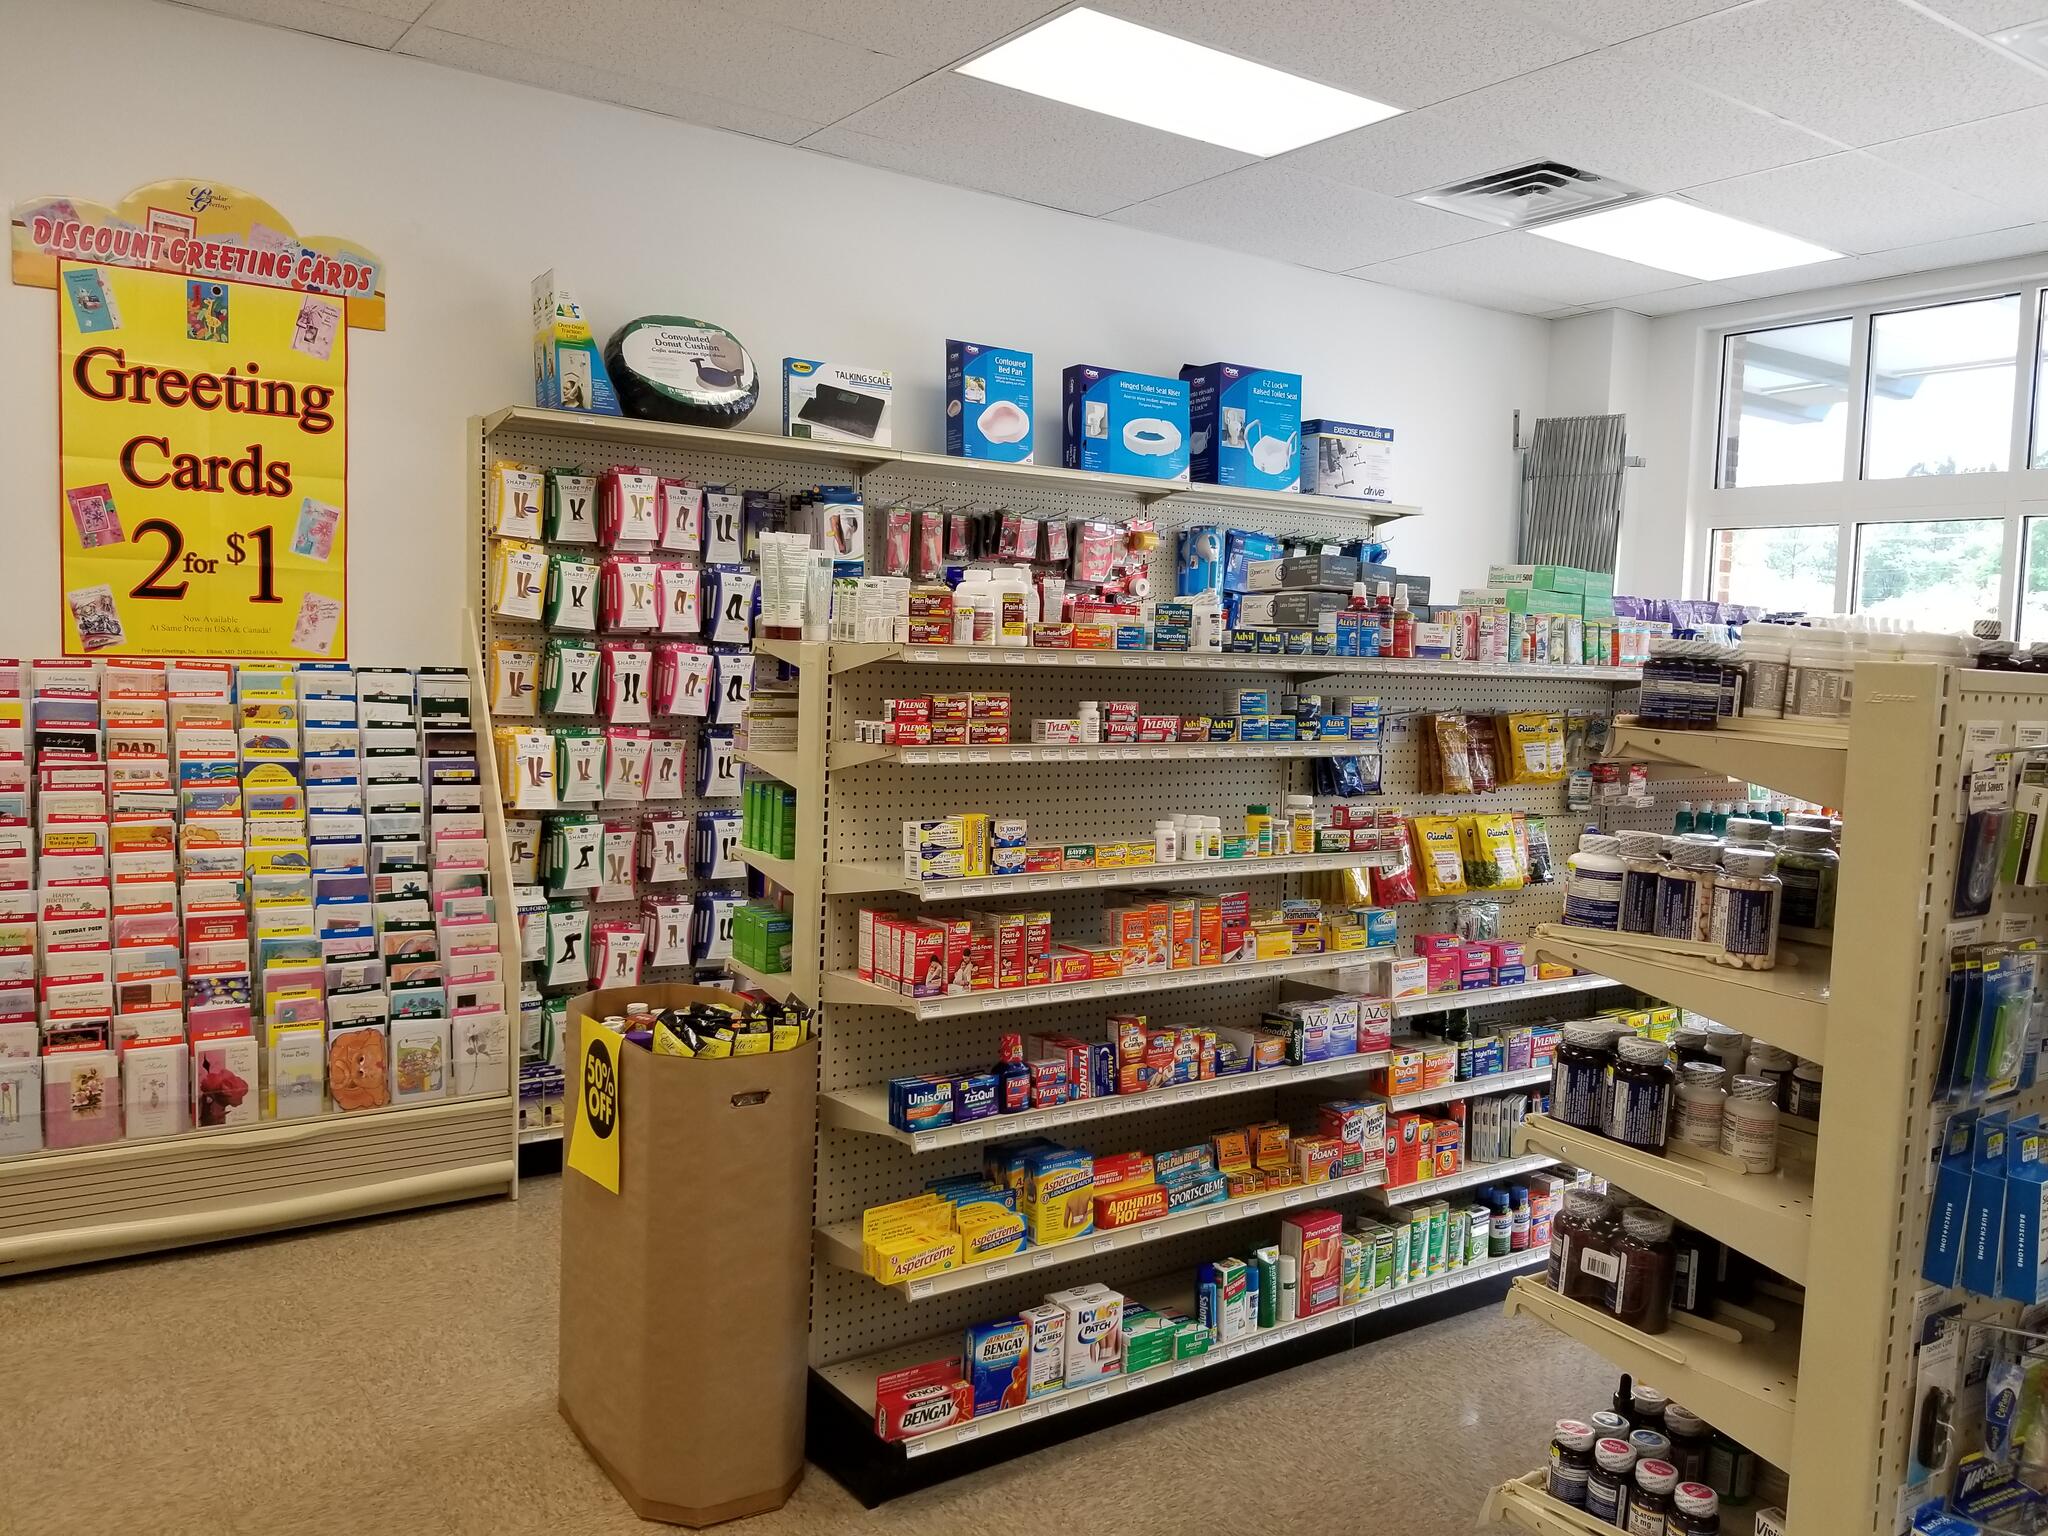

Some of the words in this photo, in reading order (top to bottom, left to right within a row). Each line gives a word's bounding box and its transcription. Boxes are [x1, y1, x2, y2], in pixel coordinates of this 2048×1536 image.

[32, 216, 166, 261] DISCOUNT
[169, 238, 299, 280] GREETING
[299, 256, 374, 292] CARDS
[660, 331, 711, 344] Convoluted
[655, 338, 682, 349] Donut
[684, 342, 720, 352] Cushion
[994, 356, 1027, 369] Contoured
[998, 366, 1010, 374] Bed
[1011, 367, 1023, 376] Pan
[835, 370, 868, 383] TALKING
[868, 375, 891, 386] SCALE
[1262, 379, 1271, 387] E-Z
[73, 346, 335, 434] Greeting
[1120, 381, 1139, 392] Hinged
[1139, 383, 1155, 394] Toilet
[1155, 385, 1167, 395] Seat
[1167, 386, 1182, 397] Riser
[1252, 387, 1270, 397] Raised
[1271, 389, 1286, 398] Toilet
[1286, 392, 1298, 400] Seat
[1333, 426, 1358, 437] EXERCISE
[1358, 429, 1382, 439] PEDDLER
[119, 435, 292, 498] Cards
[1363, 486, 1386, 497] drive
[129, 518, 190, 601] 2
[182, 552, 219, 574] for
[226, 525, 283, 604] $1
[510, 558, 530, 566] SHAPE
[1522, 574, 1533, 582] 500
[911, 596, 924, 604] Pain
[924, 597, 941, 605] Relief
[1494, 597, 1505, 605] 500
[1004, 603, 1018, 611] Pain
[1158, 608, 1190, 616] Ibuprofen
[183, 615, 201, 623] Now
[203, 615, 239, 624] Available
[1337, 618, 1358, 627] ALEVE
[1361, 619, 1380, 627] ALEVE
[184, 625, 203, 633] Price
[214, 625, 231, 633] USA
[242, 626, 272, 634] Canada!
[1156, 632, 1186, 641] Ibuprofen
[1234, 631, 1255, 642] Advil
[1261, 633, 1282, 643] Advil
[898, 700, 928, 710] TYLENOL
[985, 700, 1000, 708] Relief
[1111, 703, 1138, 712] TYLENOL
[1111, 724, 1138, 733] TYLENOL
[1142, 718, 1177, 730] TYLENOL
[1212, 719, 1233, 730] Advil
[1326, 719, 1345, 728] ALEVE
[117, 741, 156, 753] DAD
[1974, 781, 1987, 795] Sight
[1987, 782, 2004, 792] Savers
[1426, 831, 1454, 841] Ricola
[1486, 828, 1509, 838] Ricola
[1066, 848, 1087, 856] BAYER
[1283, 910, 1319, 920] Dramamine
[1001, 932, 1014, 940] Pain
[1001, 937, 1017, 946] Fever
[1027, 935, 1044, 944] Fever
[1332, 1011, 1356, 1025] AZO
[1364, 1006, 1389, 1018] AZO
[1305, 1014, 1329, 1027] AZO
[1262, 1026, 1292, 1038] Goody's
[1123, 1040, 1145, 1049] Cramps
[1129, 1036, 1139, 1044] Leg
[1533, 1036, 1562, 1047] TYLENO
[1176, 1048, 1197, 1057] Cramps
[1107, 1055, 1115, 1078] ALEVE
[1425, 1057, 1451, 1069] Daytime
[587, 1054, 615, 1098] 50%
[1038, 1066, 1066, 1076] TYLENOL
[1079, 1048, 1089, 1098] TYLENOL
[1394, 1066, 1419, 1078] DayQuil
[1007, 1079, 1030, 1088] TYLENOL
[908, 1089, 952, 1106] Unisom
[964, 1089, 996, 1103] ZzzQuil
[1039, 1087, 1067, 1097] TYLENOL
[589, 1086, 612, 1125] OFF
[1343, 1117, 1363, 1131] Move
[1366, 1113, 1385, 1127] Move
[1346, 1126, 1362, 1138] Free
[1368, 1121, 1383, 1134] Free
[1438, 1127, 1458, 1138] Delsym
[1156, 1158, 1171, 1172] FAST
[1170, 1154, 1183, 1168] PAIN
[1183, 1150, 1201, 1164] RELIEF
[1311, 1149, 1339, 1161] DOAN'S
[1042, 1168, 1092, 1193] Aspercreme
[1050, 1182, 1077, 1198] LIDOCAINE
[1076, 1178, 1093, 1190] PATCH
[1169, 1177, 1225, 1207] SPORTSCREME
[1108, 1190, 1163, 1215] ARTHRITIS
[1115, 1209, 1138, 1225] HOT
[1981, 1207, 1989, 1235] BAUSCH
[970, 1222, 1020, 1248] Aspercreme
[1305, 1224, 1341, 1238] ThermaCare
[893, 1245, 956, 1277] Aspercreme
[1078, 1308, 1096, 1325] ICY
[1034, 1323, 1049, 1334] ICY
[1084, 1320, 1112, 1335] PATCH
[1038, 1336, 1048, 1344] NO
[1048, 1332, 1062, 1341] MESS
[983, 1335, 1025, 1357] BENGAY
[905, 1385, 944, 1400] BENGAY
[902, 1401, 955, 1429] BENGAY
